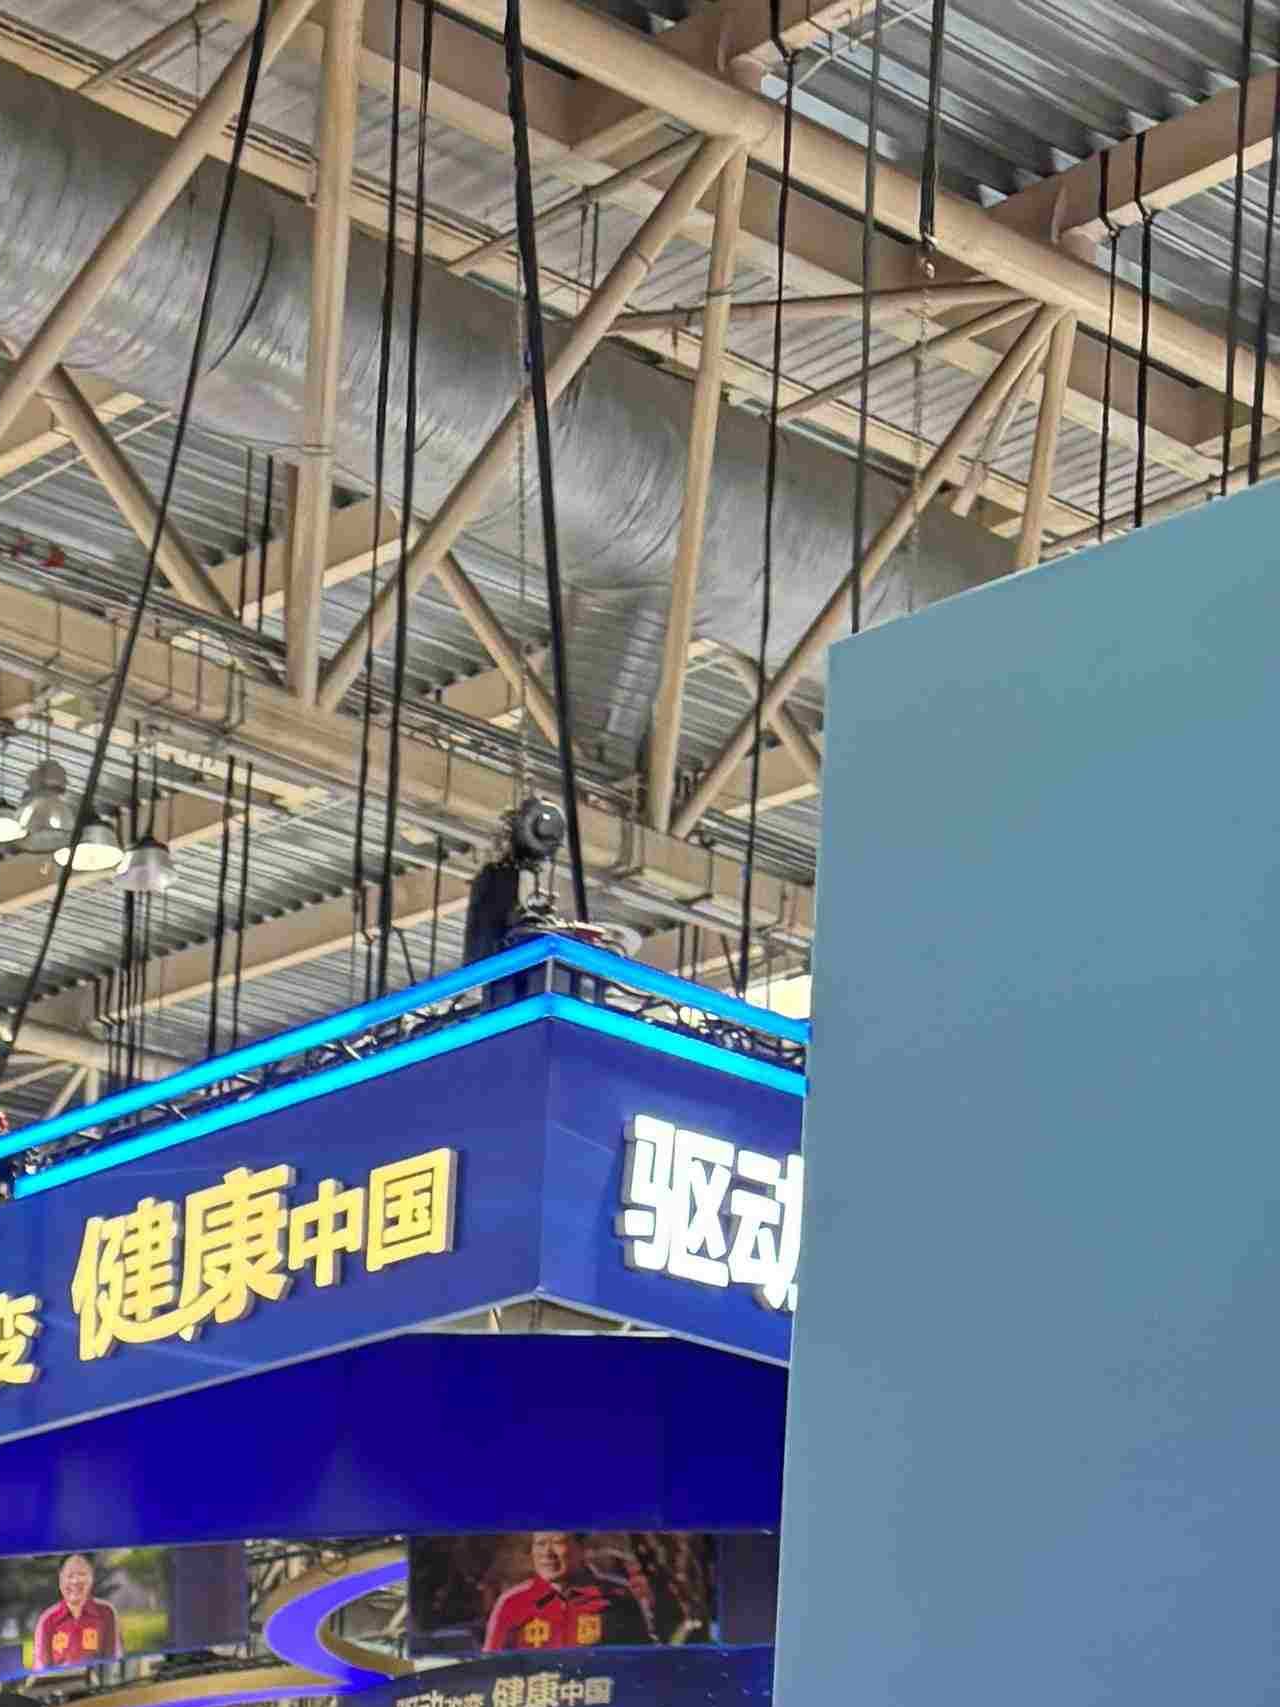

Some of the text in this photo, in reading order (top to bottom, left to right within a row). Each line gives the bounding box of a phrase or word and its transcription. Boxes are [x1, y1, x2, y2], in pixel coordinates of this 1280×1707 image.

[71, 1147, 455, 1361] 健康中国
[618, 1113, 805, 1312] 驱动
